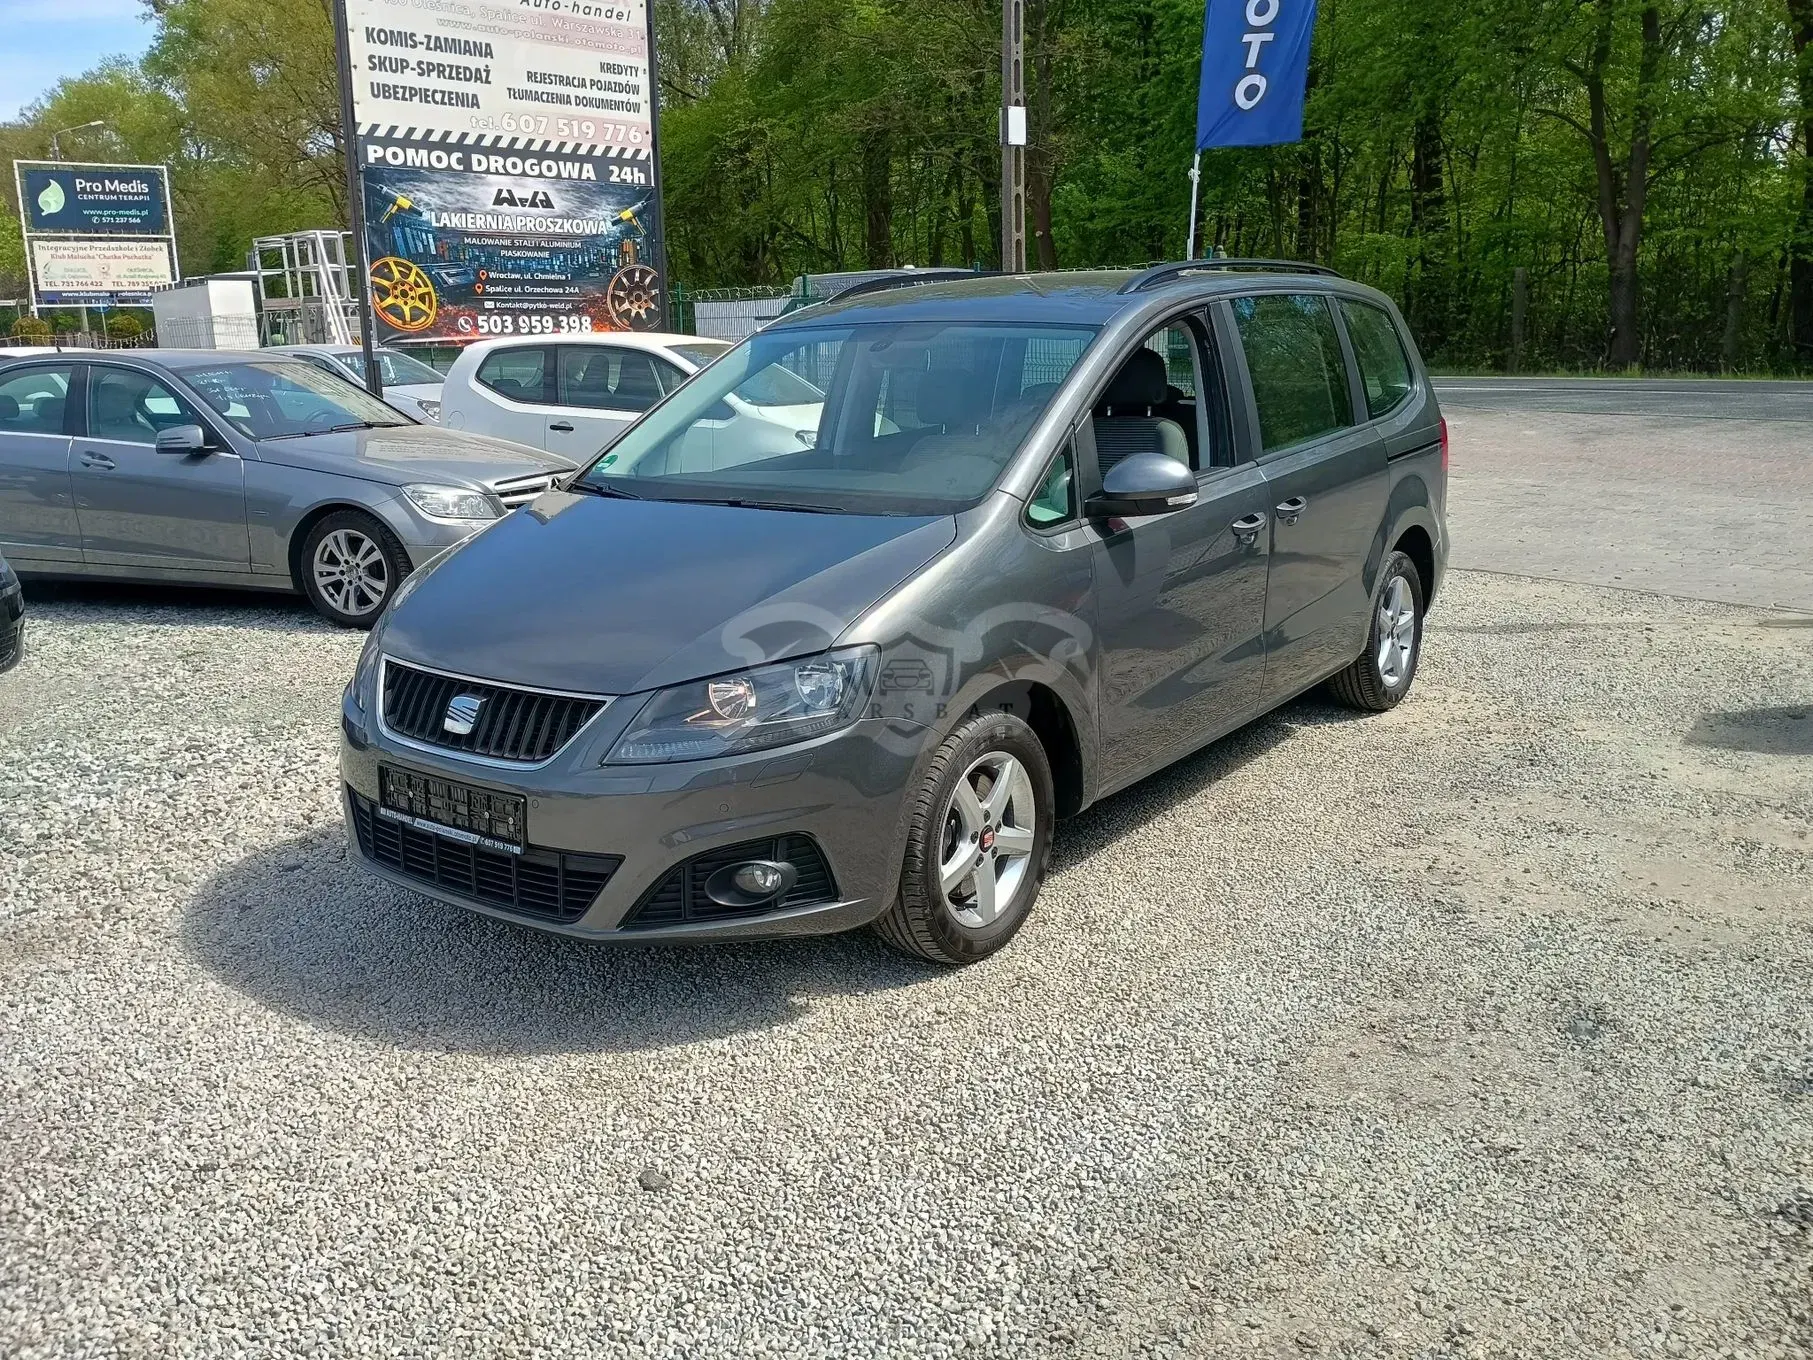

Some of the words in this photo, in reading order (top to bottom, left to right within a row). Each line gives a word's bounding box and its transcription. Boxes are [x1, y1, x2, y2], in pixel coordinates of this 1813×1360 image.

[480, 6, 527, 24] Spalice
[530, 15, 546, 26] ul.
[552, 17, 623, 38] Warszawska
[365, 26, 494, 59] KOMIS-ZAMIANA
[367, 54, 492, 85] SKUP-SPRZEDAŻ
[599, 61, 639, 78] KREDYTY
[527, 71, 588, 88] REJESTRACJA
[589, 77, 640, 96] POJAZDÓW
[370, 82, 481, 110] UBEZPIECZENIA
[507, 87, 573, 106] TŁUMACZENIA
[574, 95, 641, 114] DOKUMENTÓW
[470, 115, 500, 132] tel.
[501, 112, 549, 135] 607
[557, 119, 596, 139] 519
[602, 123, 643, 144] 776
[366, 144, 464, 171] POMOC
[471, 153, 596, 181] DROGOWA
[609, 165, 646, 184] 24h
[75, 179, 102, 192] Pro
[104, 179, 149, 193] Medis
[82, 208, 149, 217] www.pro-medis.pl
[101, 216, 114, 224] 571
[115, 216, 128, 224] 237
[430, 210, 515, 232] LAKIERNIA
[516, 214, 608, 235] PROSZKOWA
[38, 245, 88, 253] Integracyjne
[464, 236, 512, 247] MALOWANIE
[513, 239, 535, 247] STALI
[540, 240, 582, 249] ALUMINIUM
[500, 249, 550, 258] PIASKOWANIE
[489, 271, 523, 280] Wrocław,
[534, 272, 566, 281] Chmielna
[485, 284, 512, 294] Spalice
[564, 286, 580, 294] 24A
[477, 315, 514, 334] 503
[518, 315, 554, 334] 959
[559, 316, 592, 334] 398
